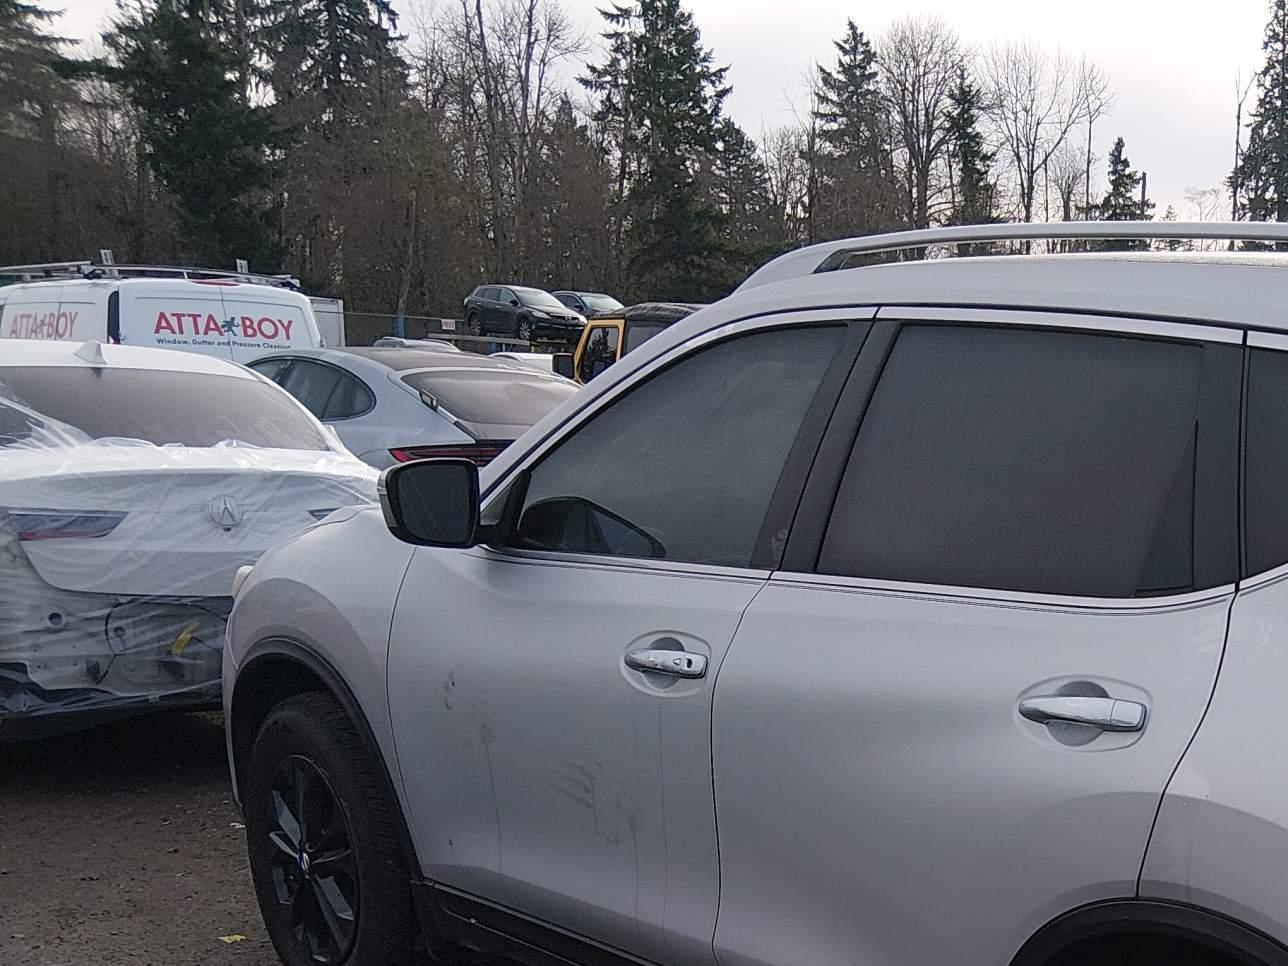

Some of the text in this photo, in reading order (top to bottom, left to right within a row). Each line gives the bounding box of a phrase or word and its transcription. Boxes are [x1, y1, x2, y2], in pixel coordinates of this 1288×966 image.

[9, 312, 79, 340] ATTA BOY
[154, 311, 293, 340] ATTA BOY
[232, 340, 262, 349] Pressure
